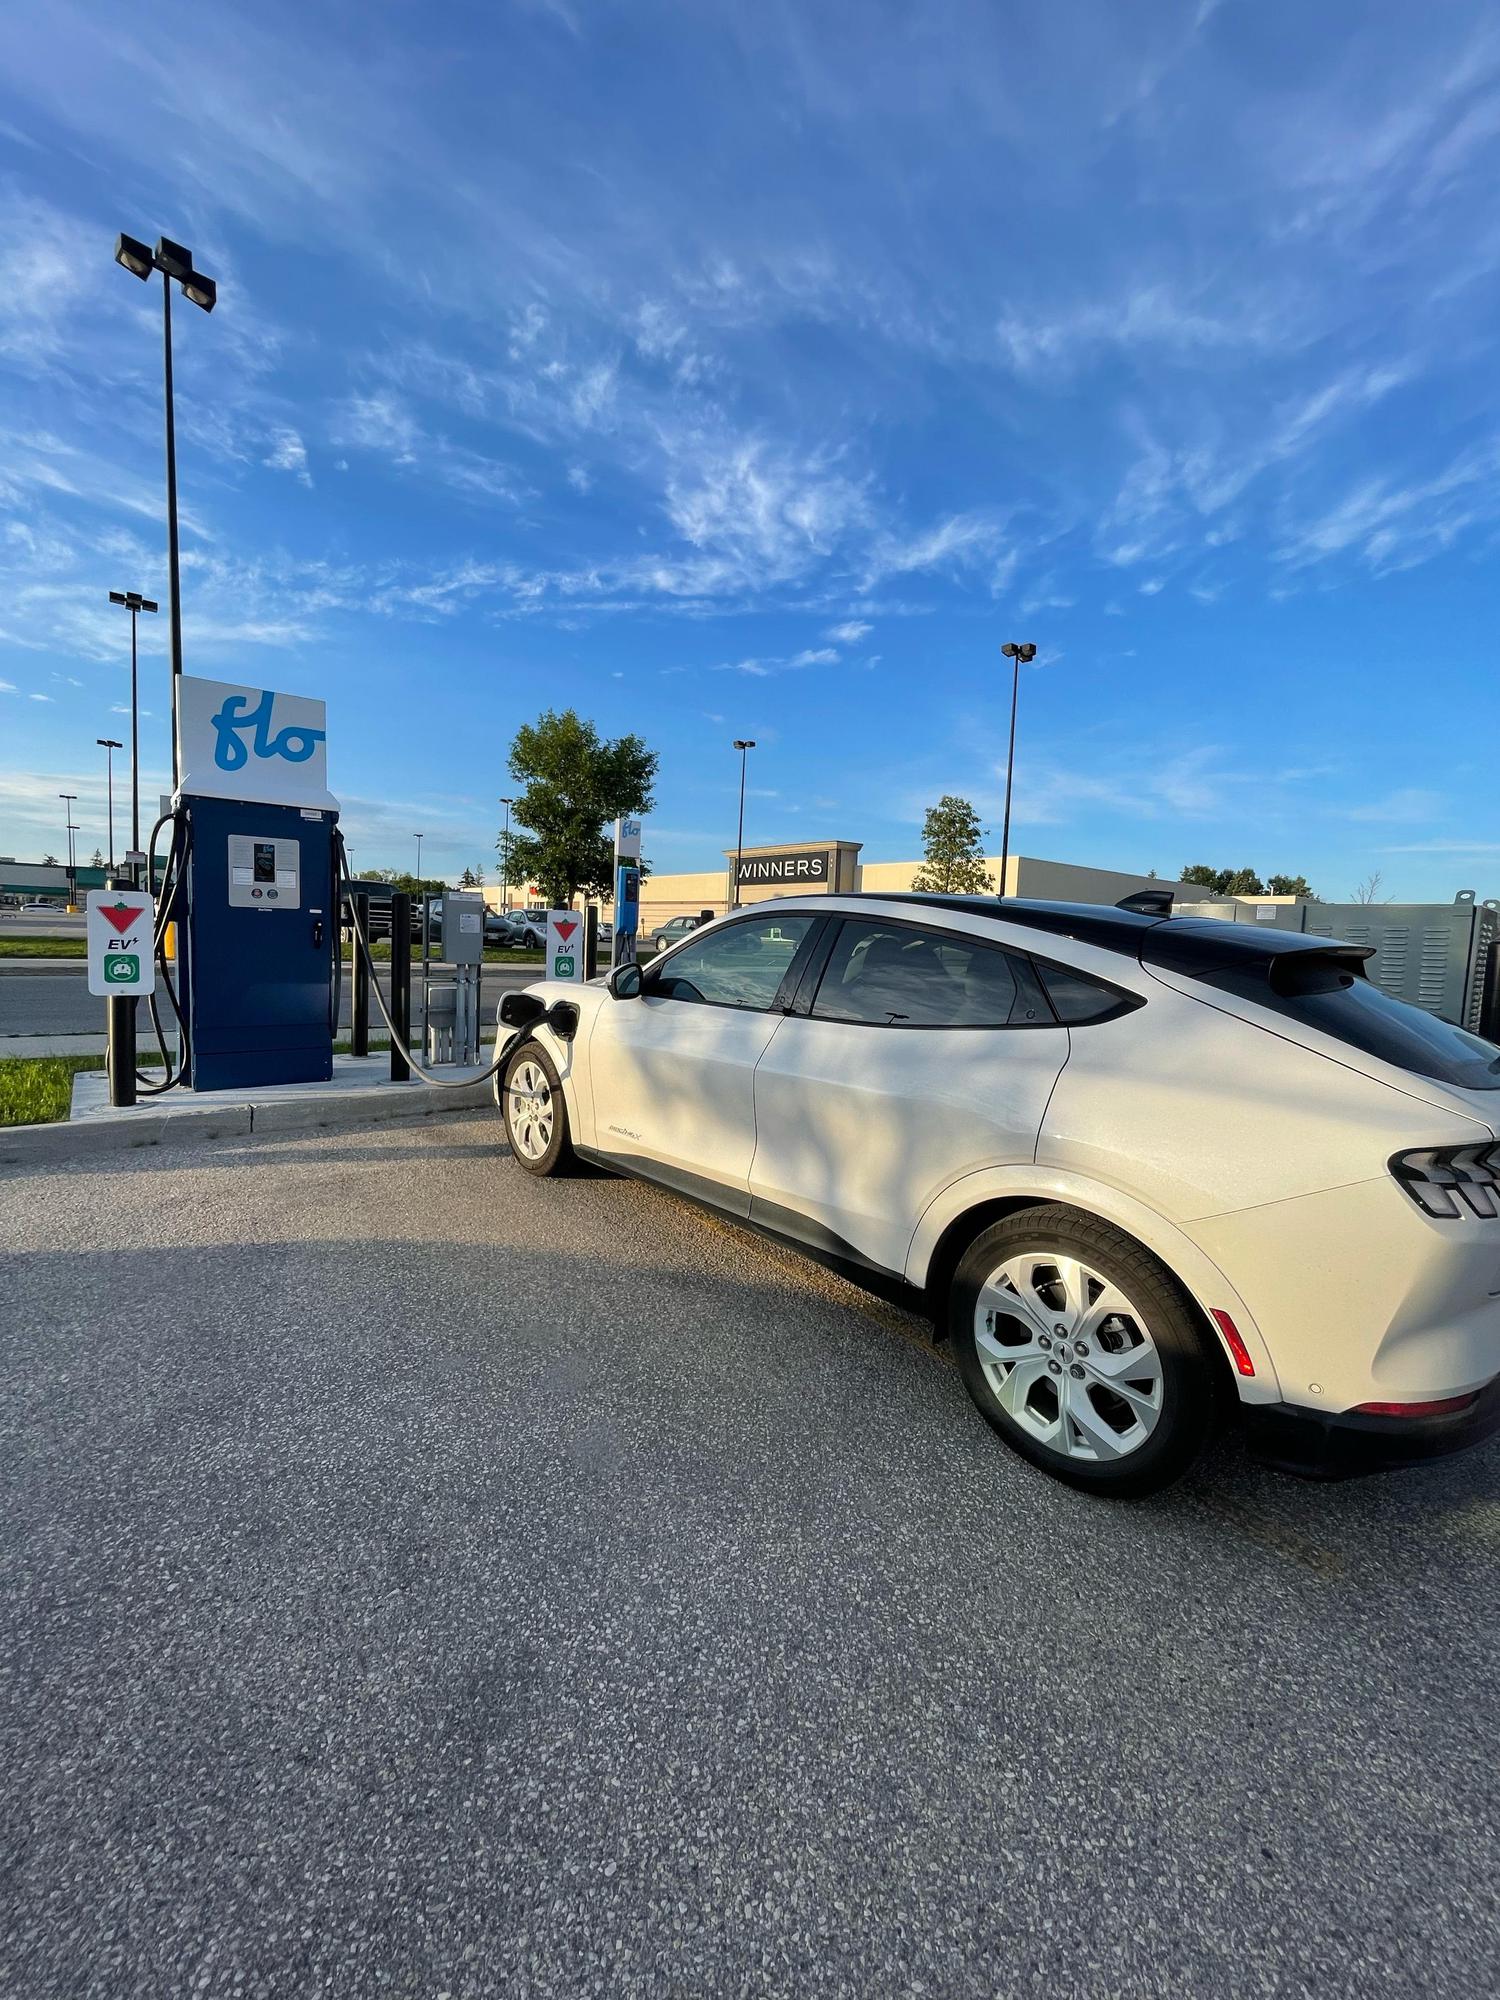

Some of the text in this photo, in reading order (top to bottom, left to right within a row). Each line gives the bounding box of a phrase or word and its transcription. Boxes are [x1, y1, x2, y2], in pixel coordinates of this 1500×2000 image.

[210, 690, 326, 771] flo
[622, 820, 640, 838] flo
[108, 939, 132, 950] EV
[557, 945, 571, 954] EV
